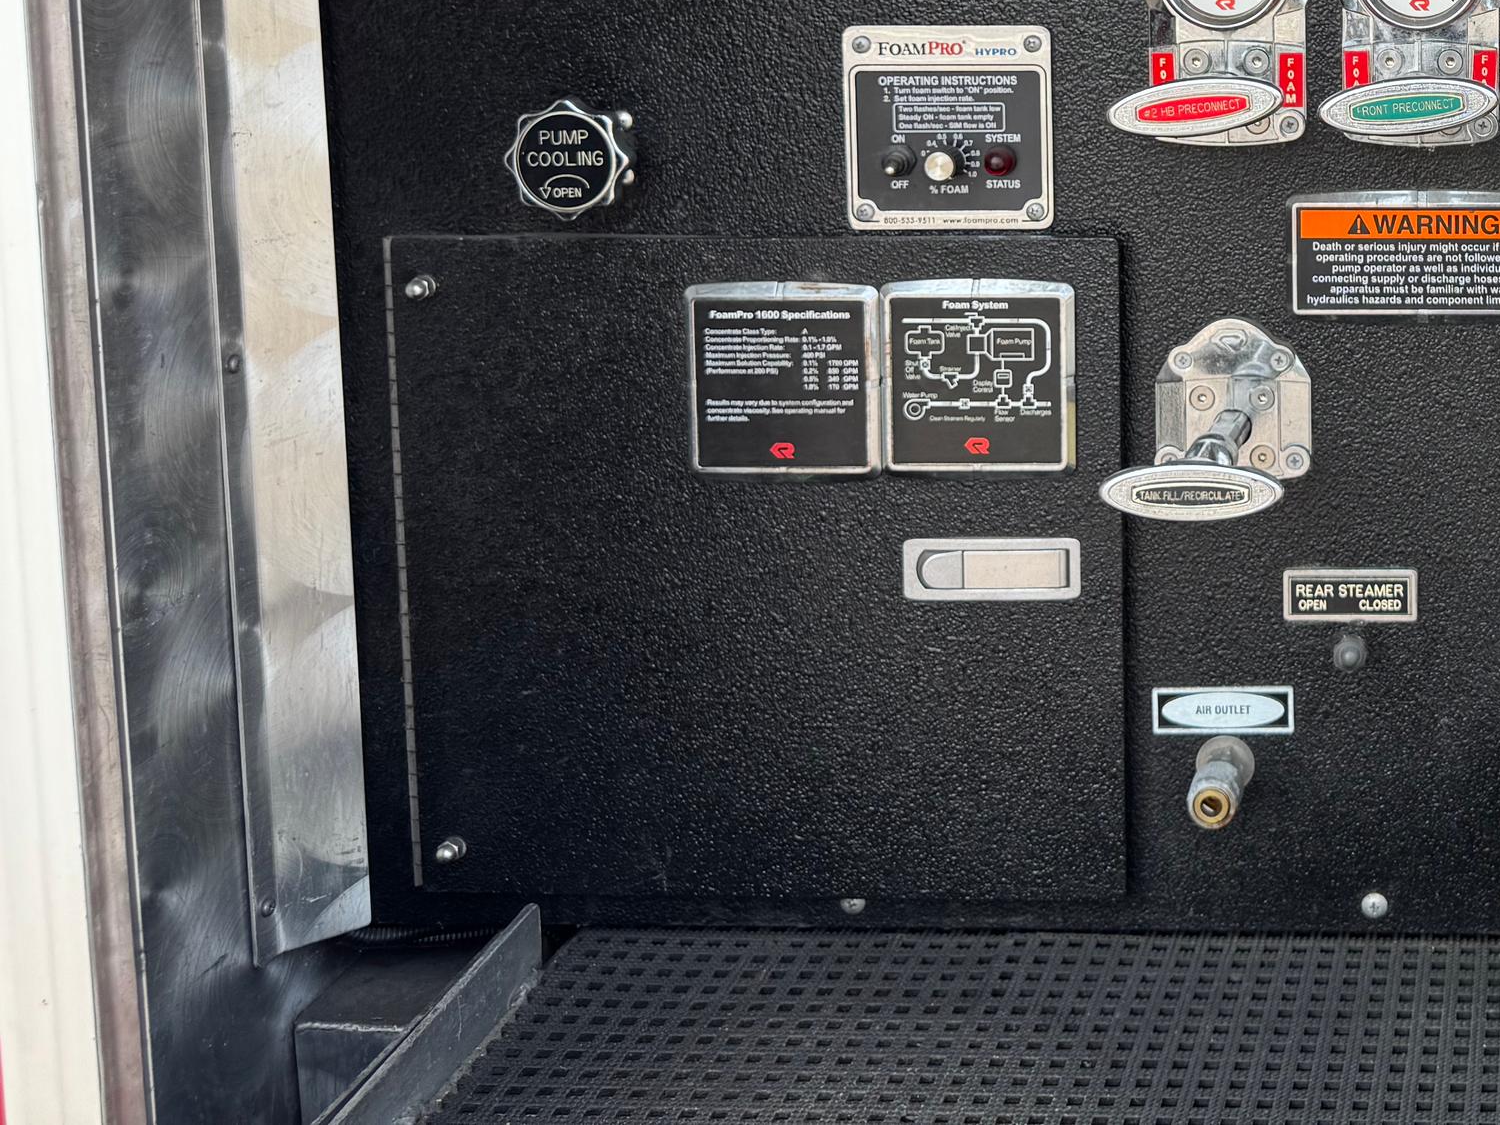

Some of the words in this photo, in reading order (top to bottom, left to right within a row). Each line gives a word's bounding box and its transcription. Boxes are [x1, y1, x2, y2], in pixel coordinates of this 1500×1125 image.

[976, 48, 1017, 56] HYPRO
[878, 77, 939, 86] OPERATING
[941, 77, 1017, 85] INSTRUCTIONS
[1144, 110, 1158, 118] #2
[1160, 107, 1175, 117] HB
[1177, 100, 1241, 115] PRECONNECT
[1392, 99, 1455, 113] PRECONNECT
[540, 130, 588, 145] PUMP
[892, 135, 905, 143] ON
[986, 134, 1021, 143] SYSTEM
[528, 151, 604, 166] COOLING
[892, 180, 909, 189] OFF
[986, 180, 1021, 188] STATUS
[554, 188, 582, 197] OPEN
[929, 186, 938, 194] %
[1373, 215, 1500, 234] WARNING
[1312, 242, 1342, 251] Death
[1345, 243, 1355, 251] or
[1358, 243, 1395, 251] serious
[1398, 243, 1426, 253] injury
[1430, 243, 1458, 253] might
[1461, 243, 1490, 252] occur
[1493, 243, 1499, 252] if
[943, 301, 970, 309] Foam
[971, 301, 1008, 310] System
[710, 311, 753, 319] FoamPro
[755, 310, 779, 319] 1600
[781, 310, 850, 319] Specifications
[1140, 490, 1161, 499] TANK
[1296, 584, 1333, 597] REAR
[1338, 584, 1403, 597] STEAMER
[1299, 600, 1326, 611] OPEN
[1359, 599, 1401, 610] CLOSED
[1196, 705, 1212, 714] AIR
[1215, 705, 1250, 714] OUTLET
